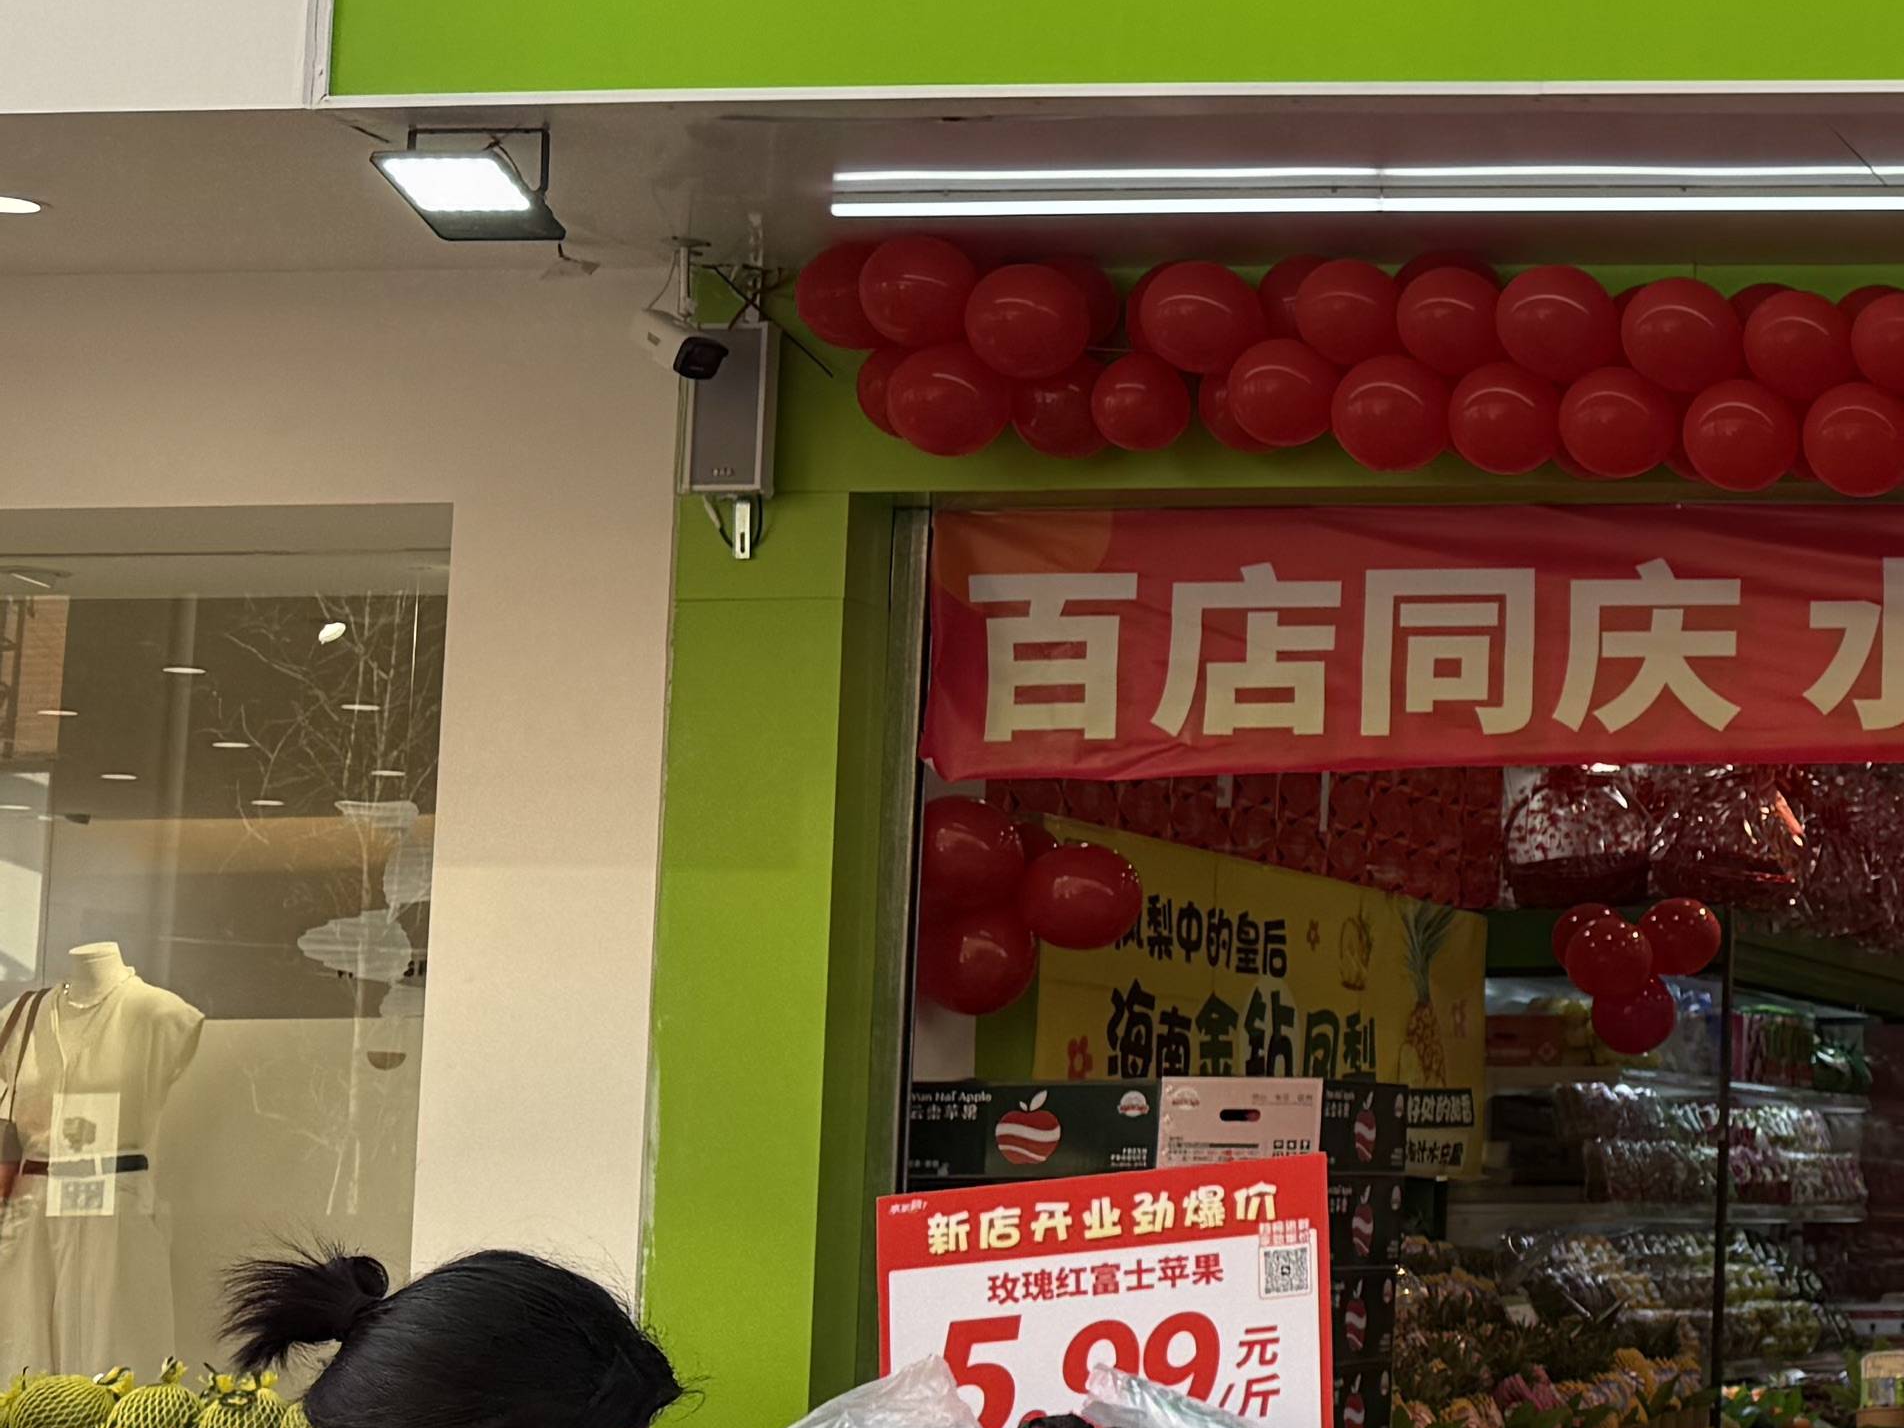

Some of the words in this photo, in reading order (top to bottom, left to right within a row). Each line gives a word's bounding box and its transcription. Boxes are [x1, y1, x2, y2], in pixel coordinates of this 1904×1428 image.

[968, 558, 1741, 743] 百店同庆
[927, 1180, 1279, 1255] 新店开业劲爆价
[987, 1253, 1224, 1305] 玫瑰红富士苹果
[1237, 1325, 1281, 1370] 元
